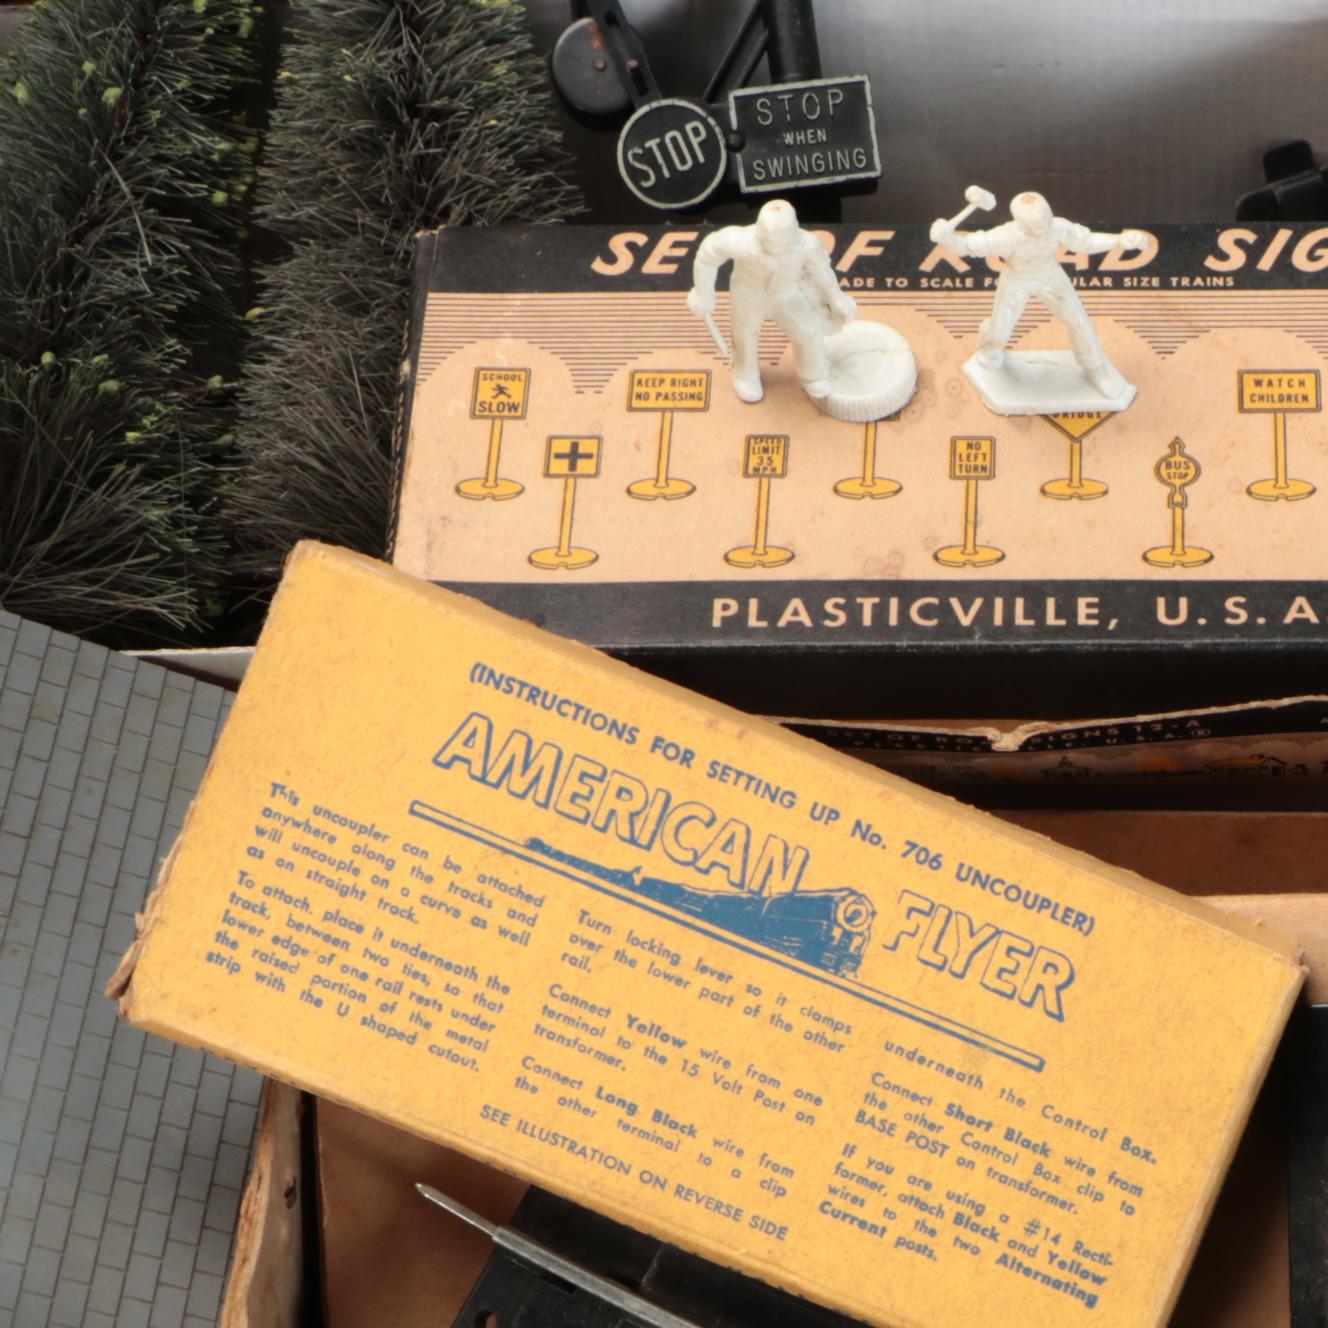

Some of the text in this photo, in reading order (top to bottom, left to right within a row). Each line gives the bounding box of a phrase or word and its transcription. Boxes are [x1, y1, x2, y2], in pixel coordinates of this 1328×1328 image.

[757, 89, 844, 126] STOP
[782, 128, 828, 147] WHEN
[627, 120, 708, 188] STOP
[752, 147, 867, 181] SWINGING
[885, 277, 908, 288] TO
[919, 277, 974, 288] SCALE
[1123, 276, 1160, 287] SIZE
[1170, 276, 1235, 287] TRAINS
[478, 400, 521, 414] SLOW
[481, 372, 523, 382] SCHOOL
[635, 391, 704, 402] NO PASSING
[636, 377, 704, 388] KEEP RIGHT
[1249, 392, 1310, 403] CHILDREN
[1253, 378, 1307, 389] WATCH
[751, 446, 782, 456] LIMIT
[752, 437, 783, 446] SPEED
[756, 456, 775, 466] 35
[958, 452, 988, 463] LEFT
[958, 463, 988, 474] TURN
[966, 441, 982, 451] NO
[1164, 459, 1191, 471] BUS
[1166, 471, 1190, 481] STOP
[712, 597, 1120, 631] PLASTICVILLE,
[469, 661, 1096, 938] (INSTRUCTIONS FOR SETTING UP No. 706 UNCOUPLER)
[260, 806, 538, 928] anywhere along tracks and
[270, 781, 546, 908] This uncoupler can be attached
[432, 711, 1076, 1023] AMERICAN FLYER
[254, 824, 531, 947] will uncouple curve well
[305, 869, 368, 902] straight
[237, 869, 479, 982] To place underneath
[205, 950, 242, 975] strip
[255, 970, 286, 993] with
[336, 1001, 350, 1018] U
[359, 1013, 419, 1046] shaped
[221, 908, 496, 1033] lower edge one rail rests under
[285, 913, 351, 951] between
[362, 947, 390, 967] two
[472, 992, 505, 1014] that
[569, 933, 846, 1053] over lower part other
[578, 908, 852, 1035] Turn locking lever clamps
[251, 948, 490, 1052] raised portion metal
[541, 1004, 786, 1112] terminal 15 Volt Post
[548, 983, 824, 1107] Connect Yellow wire from one
[521, 1055, 795, 1178] Connect Long Black wire from
[883, 1041, 984, 1090] underneath
[1040, 1103, 1109, 1142] Control
[557, 1096, 788, 1199] other terminal clip
[854, 1108, 898, 1138] BASE
[905, 1130, 951, 1158] POST
[870, 1071, 1145, 1198] Connect Short Black wire from
[903, 1112, 1105, 1203] other Control Box clip
[479, 1103, 789, 1242] SEE ILLUSTRATION ON REVERSE SIDE
[841, 1142, 858, 1159] If
[865, 1156, 895, 1176] you
[906, 1174, 934, 1192] are
[945, 1190, 986, 1217] using
[818, 1200, 888, 1239] Current
[828, 1184, 1100, 1310] wires two Alternating
[897, 1193, 1109, 1287] attach Black and Yellow
